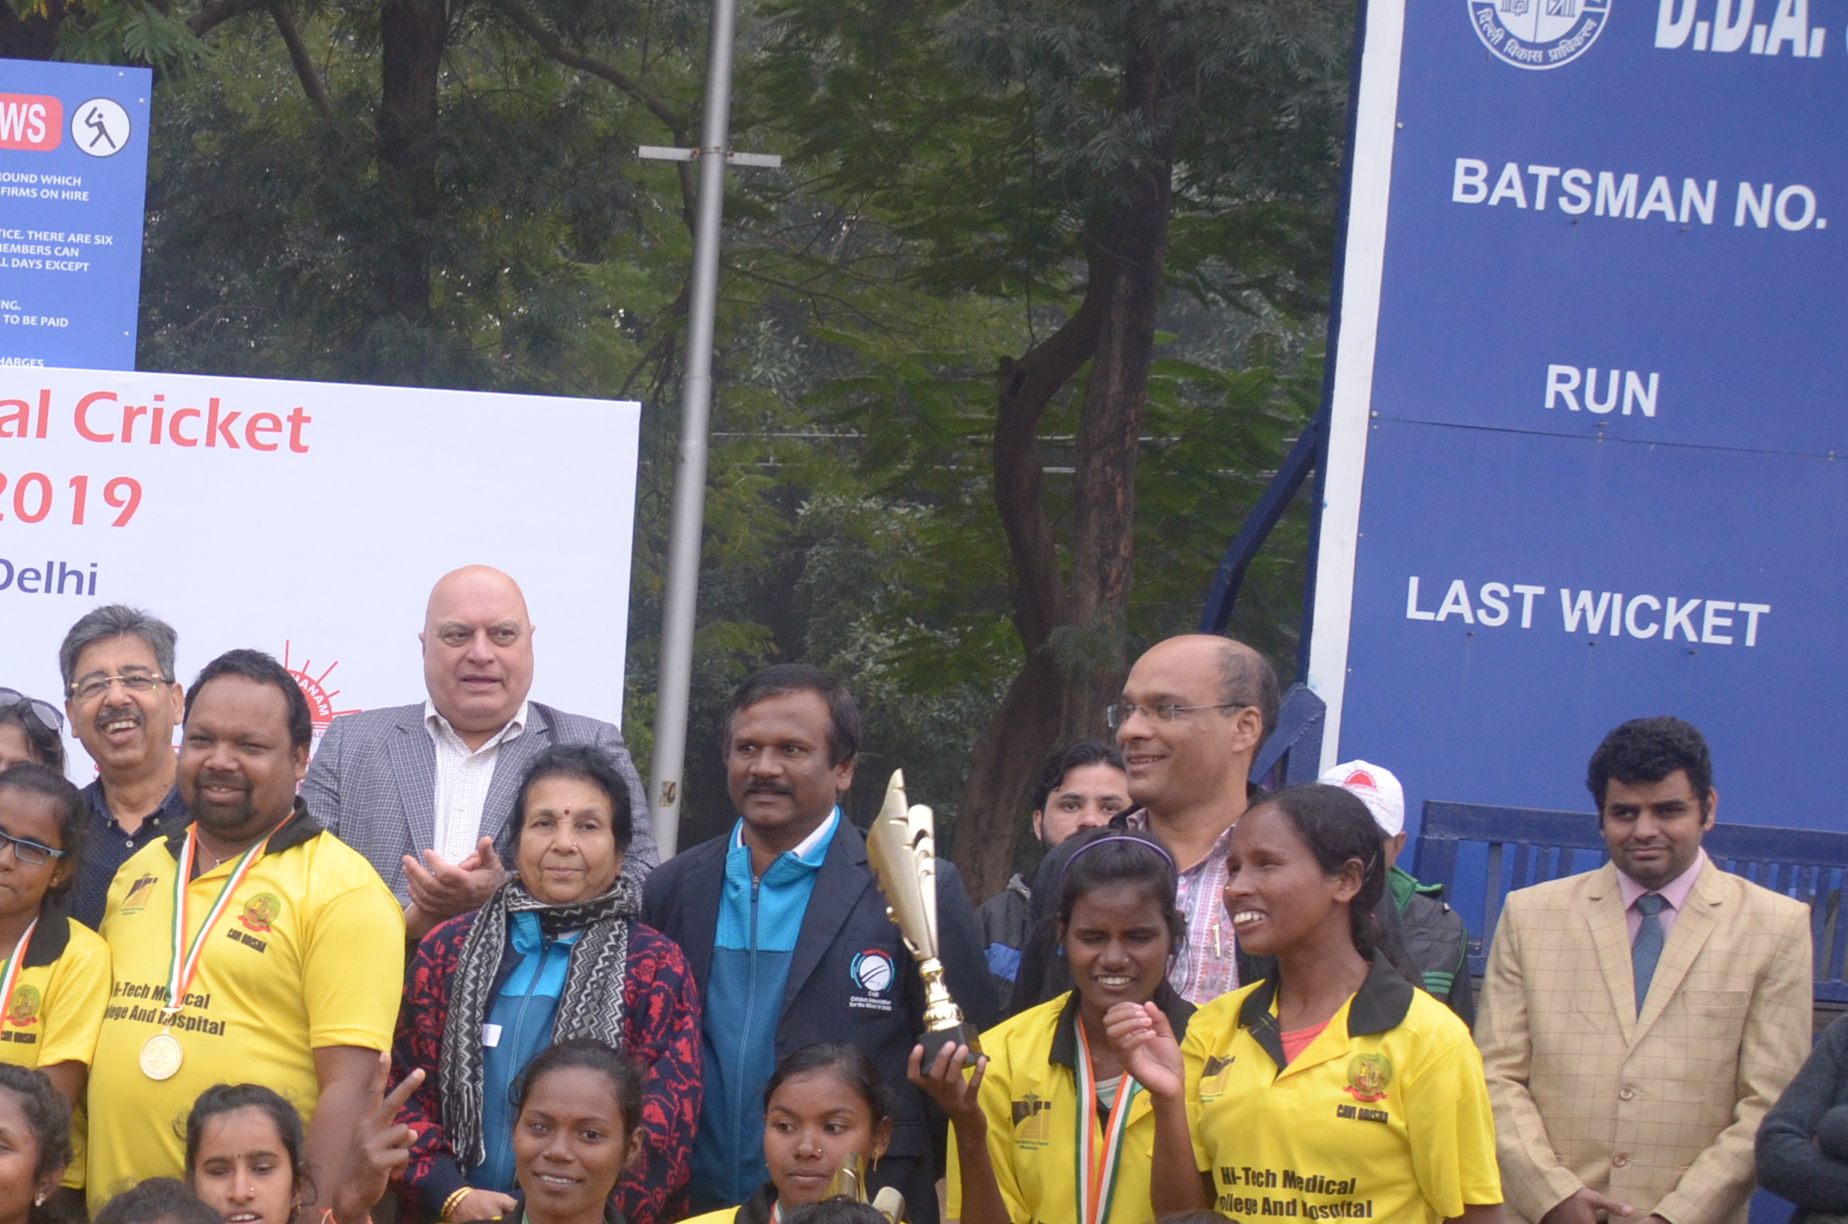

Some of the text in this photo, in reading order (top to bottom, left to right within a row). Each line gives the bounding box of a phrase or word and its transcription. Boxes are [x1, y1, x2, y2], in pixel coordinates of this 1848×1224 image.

[40, 175, 81, 186] WHICH
[0, 186, 37, 197] FIRMS
[40, 188, 58, 198] ON
[62, 190, 88, 200] HIRE
[1453, 159, 1825, 230] BATSMAN NO.
[27, 230, 64, 241] THERE
[67, 233, 90, 243] ARE
[94, 235, 112, 244] SIX
[54, 246, 78, 257] CAN
[11, 258, 42, 269] DAYS
[45, 260, 89, 271] EXCEPT
[3, 314, 19, 324] TO
[22, 315, 36, 325] BE
[40, 316, 68, 327] PAID
[1545, 365, 1658, 416] RUN
[74, 391, 312, 453] Cricket
[1407, 577, 1770, 646] LAST WICKET
[129, 1006, 157, 1023] And
[1220, 1167, 1356, 1195] Hi-Tech Medical
[1220, 1194, 1297, 1217] ollege And
